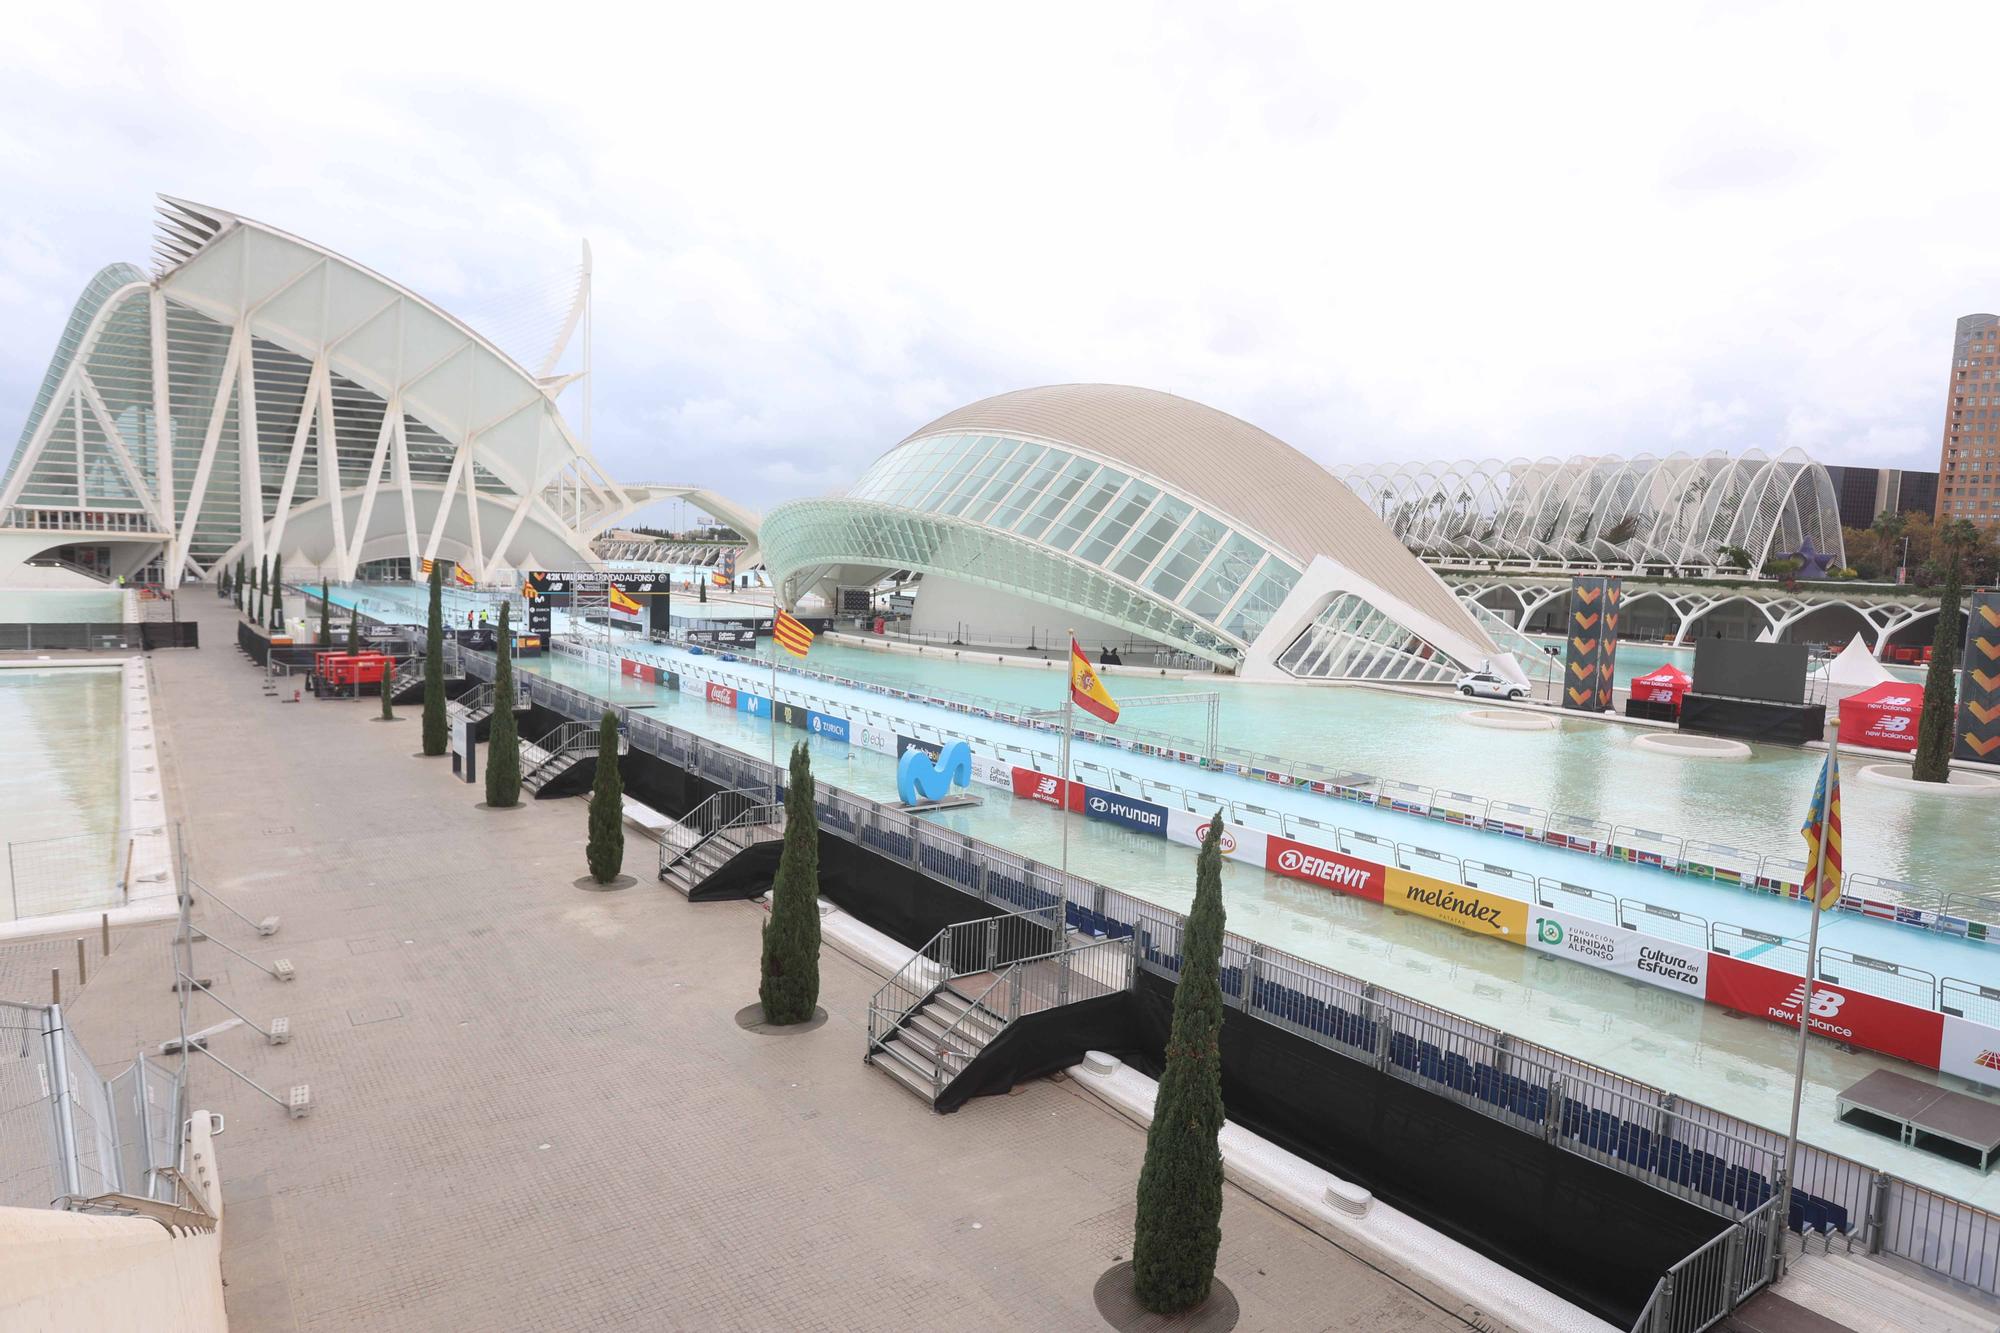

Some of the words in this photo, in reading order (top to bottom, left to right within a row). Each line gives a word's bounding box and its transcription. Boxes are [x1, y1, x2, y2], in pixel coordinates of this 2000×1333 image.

[545, 573, 561, 581] 42K
[625, 574, 655, 582] ALFONSO
[822, 721, 845, 736] ZURICH
[870, 732, 885, 750] edp
[1110, 802, 1161, 828] HYUNDAI
[1300, 855, 1371, 890] ENERVIT
[1406, 885, 1502, 929] meléndez
[1568, 933, 1614, 953] TRINIDAD
[1568, 943, 1614, 961] ALFONSO
[1639, 946, 1687, 969] Cultura
[1686, 963, 1699, 973] del
[1637, 958, 1699, 985] Esfuerzo
[1768, 1006, 1794, 1021] new
